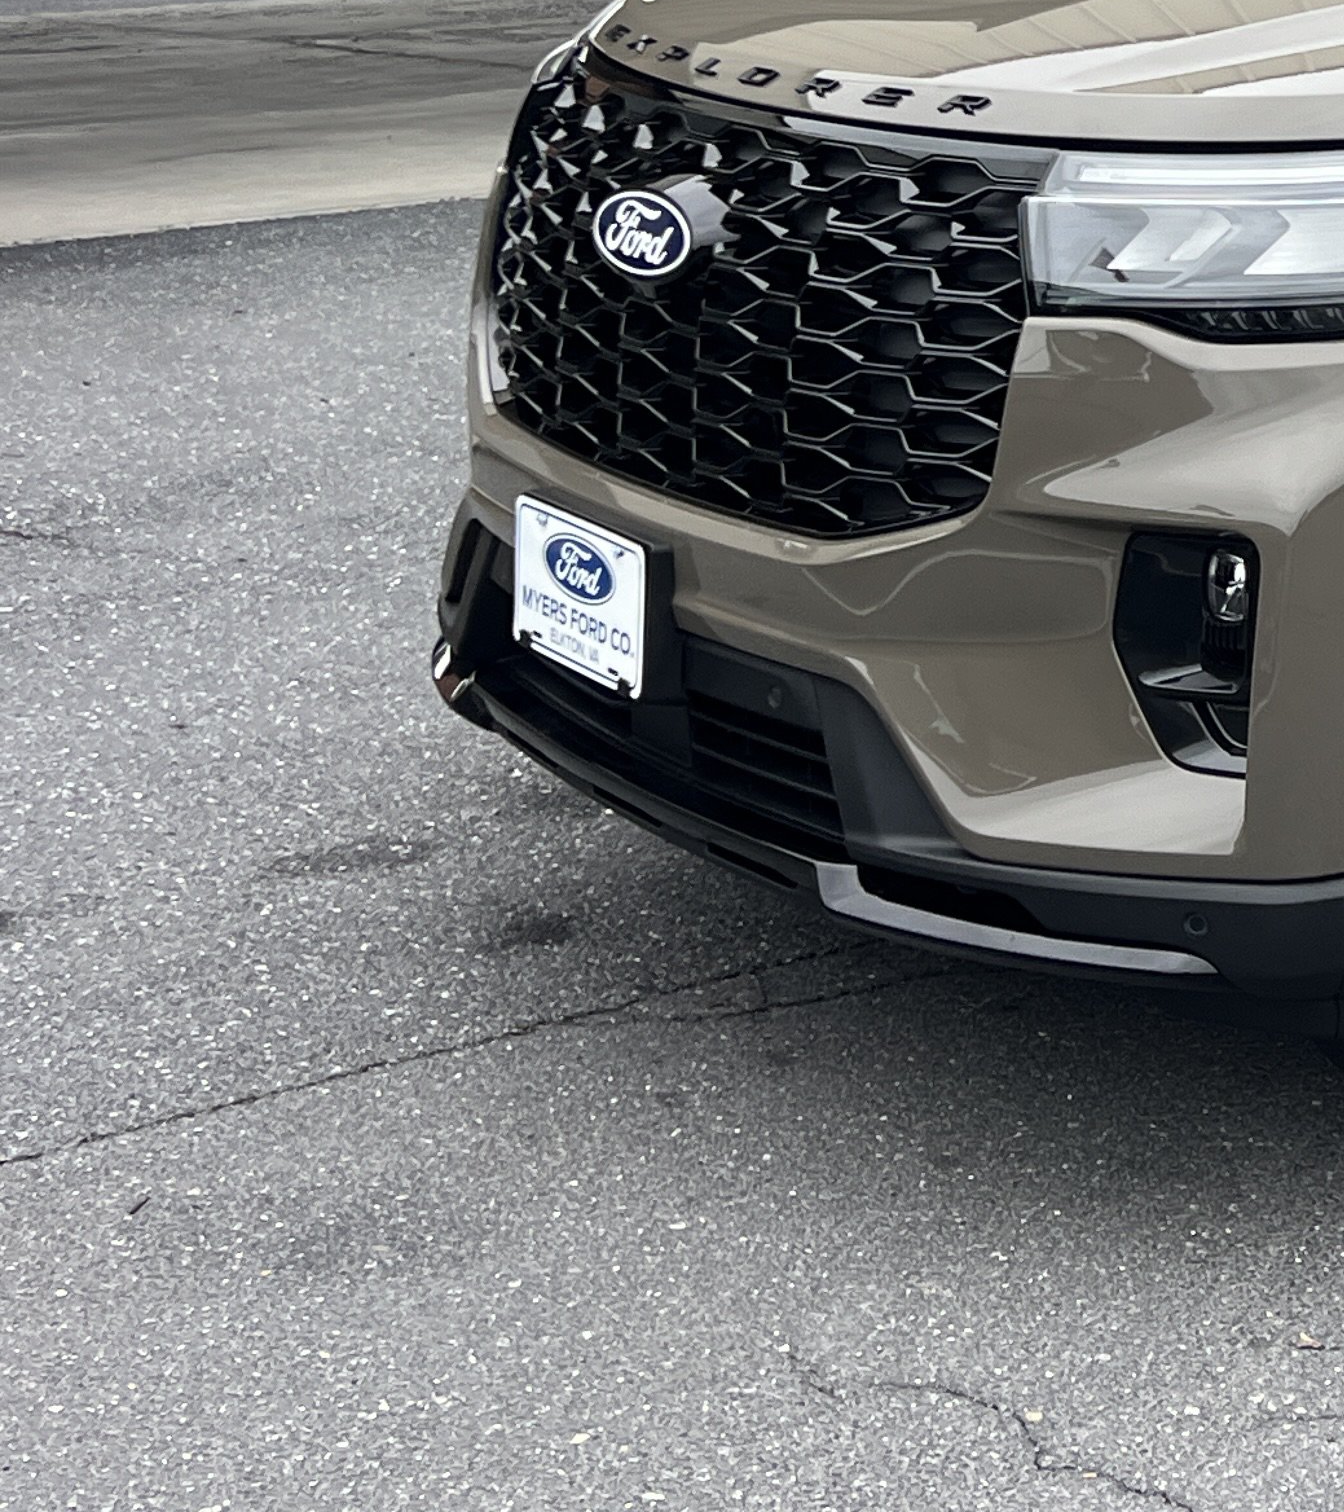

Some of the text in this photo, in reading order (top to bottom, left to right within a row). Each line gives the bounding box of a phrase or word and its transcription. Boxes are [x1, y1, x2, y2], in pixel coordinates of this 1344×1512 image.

[605, 23, 993, 117] EXPLORER
[605, 200, 674, 265] Ford
[555, 542, 602, 595] Ford
[522, 584, 568, 626] MYERS
[569, 607, 608, 644] FORD
